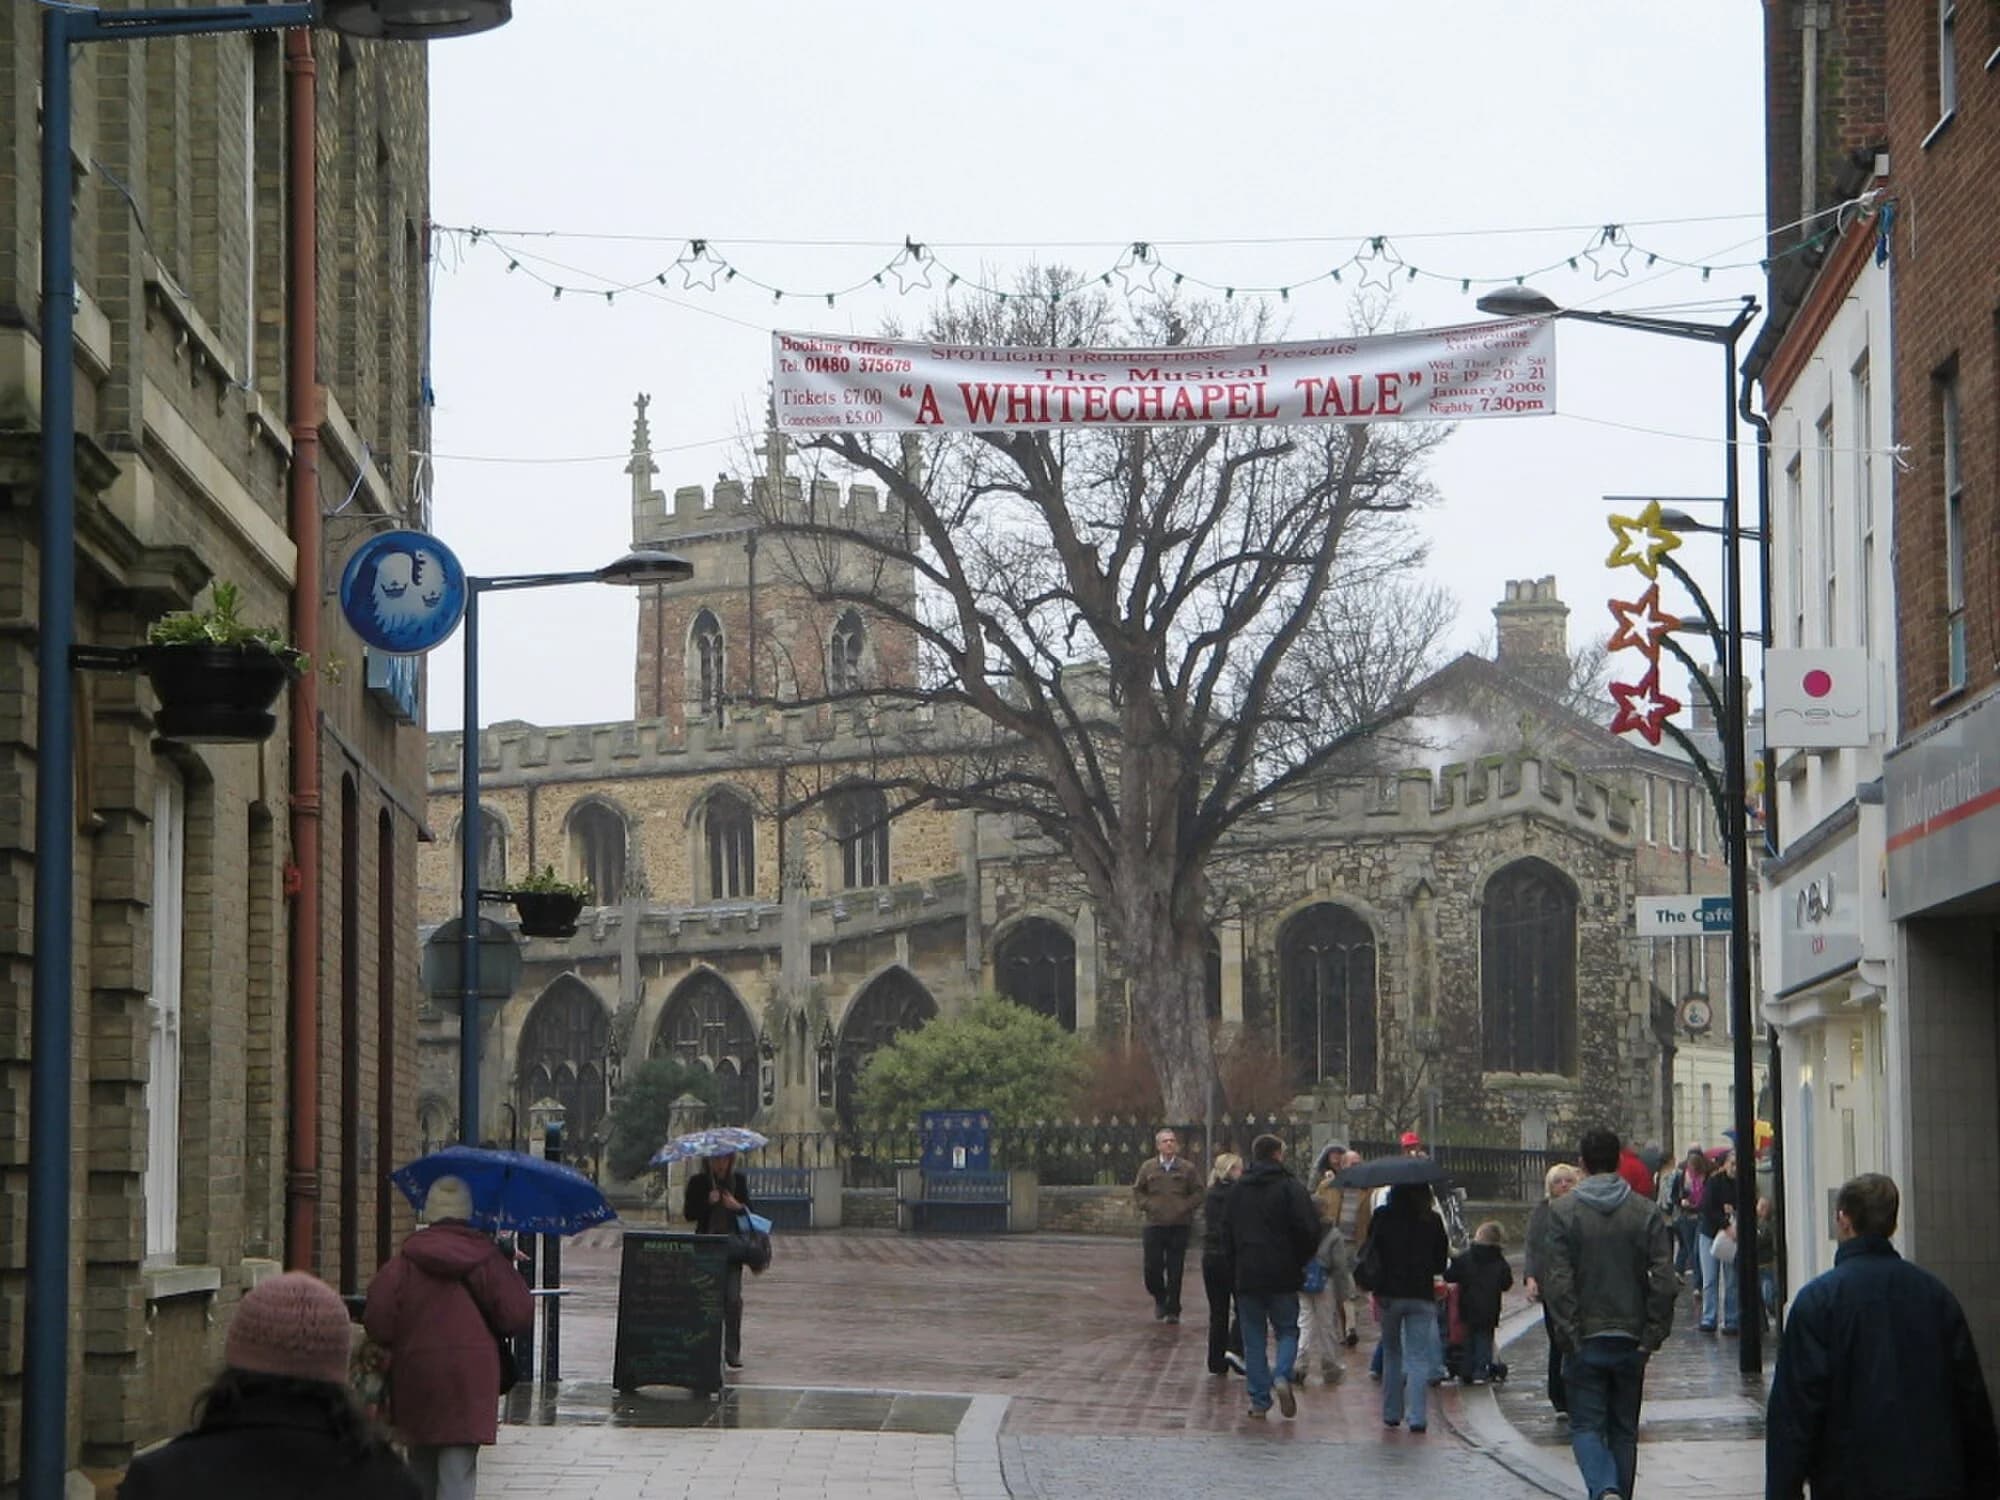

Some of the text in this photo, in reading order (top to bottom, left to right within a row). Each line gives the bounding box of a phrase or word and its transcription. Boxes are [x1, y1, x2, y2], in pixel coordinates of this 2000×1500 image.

[780, 336, 894, 356] Booking Office
[1482, 340, 1531, 351] Centre
[931, 348, 1056, 363] SPOTLIGHT
[805, 357, 850, 373] 01480
[859, 357, 911, 373] 375678
[1035, 364, 1270, 382] The Musical
[781, 389, 882, 405] Tickets £7.00
[1430, 383, 1546, 399] January 2006
[958, 382, 1279, 425] WHITECHAPEL
[1429, 396, 1544, 414] Nightly 7.30pm
[781, 410, 882, 426] Concessions £5.00
[1656, 909, 1686, 923] The
